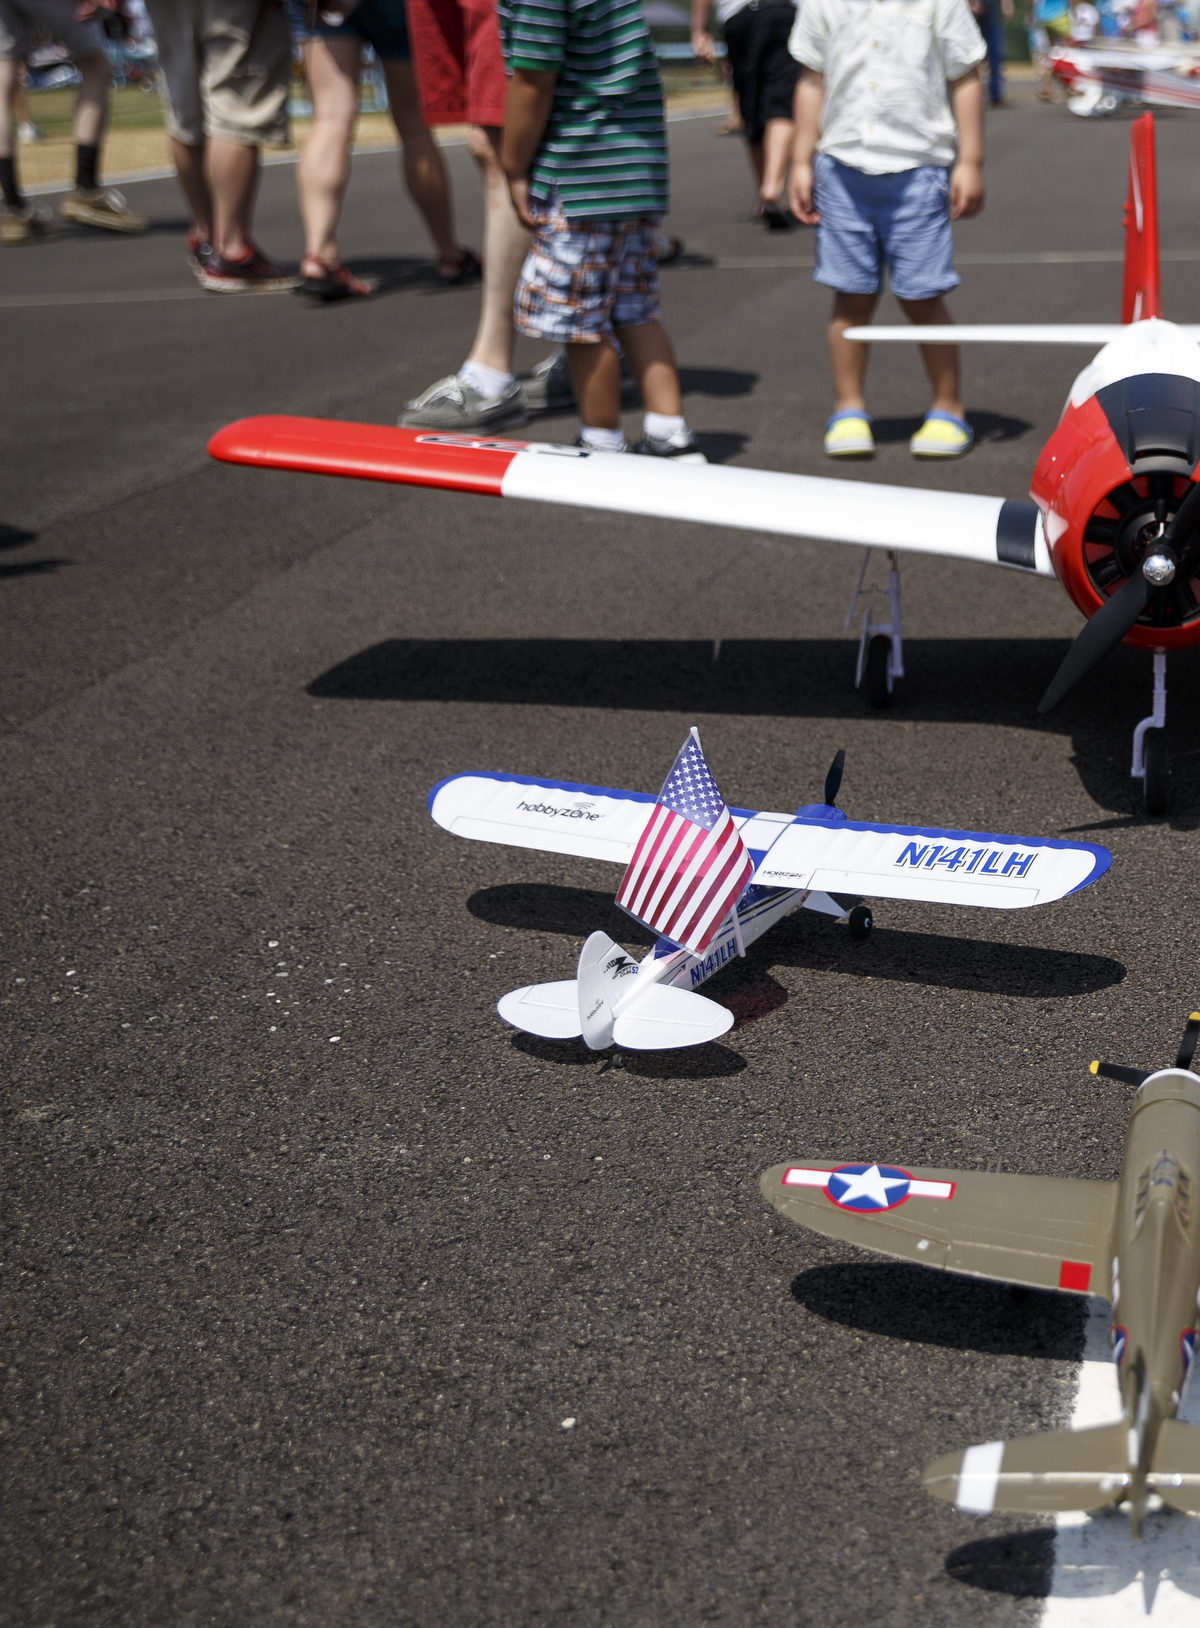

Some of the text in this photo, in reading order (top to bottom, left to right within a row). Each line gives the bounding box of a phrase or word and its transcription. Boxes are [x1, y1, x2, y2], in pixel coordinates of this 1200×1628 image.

[517, 801, 600, 821] hobbyzone
[894, 842, 1038, 878] N141LH
[631, 965, 640, 974] S2
[690, 937, 737, 987] N141LH
